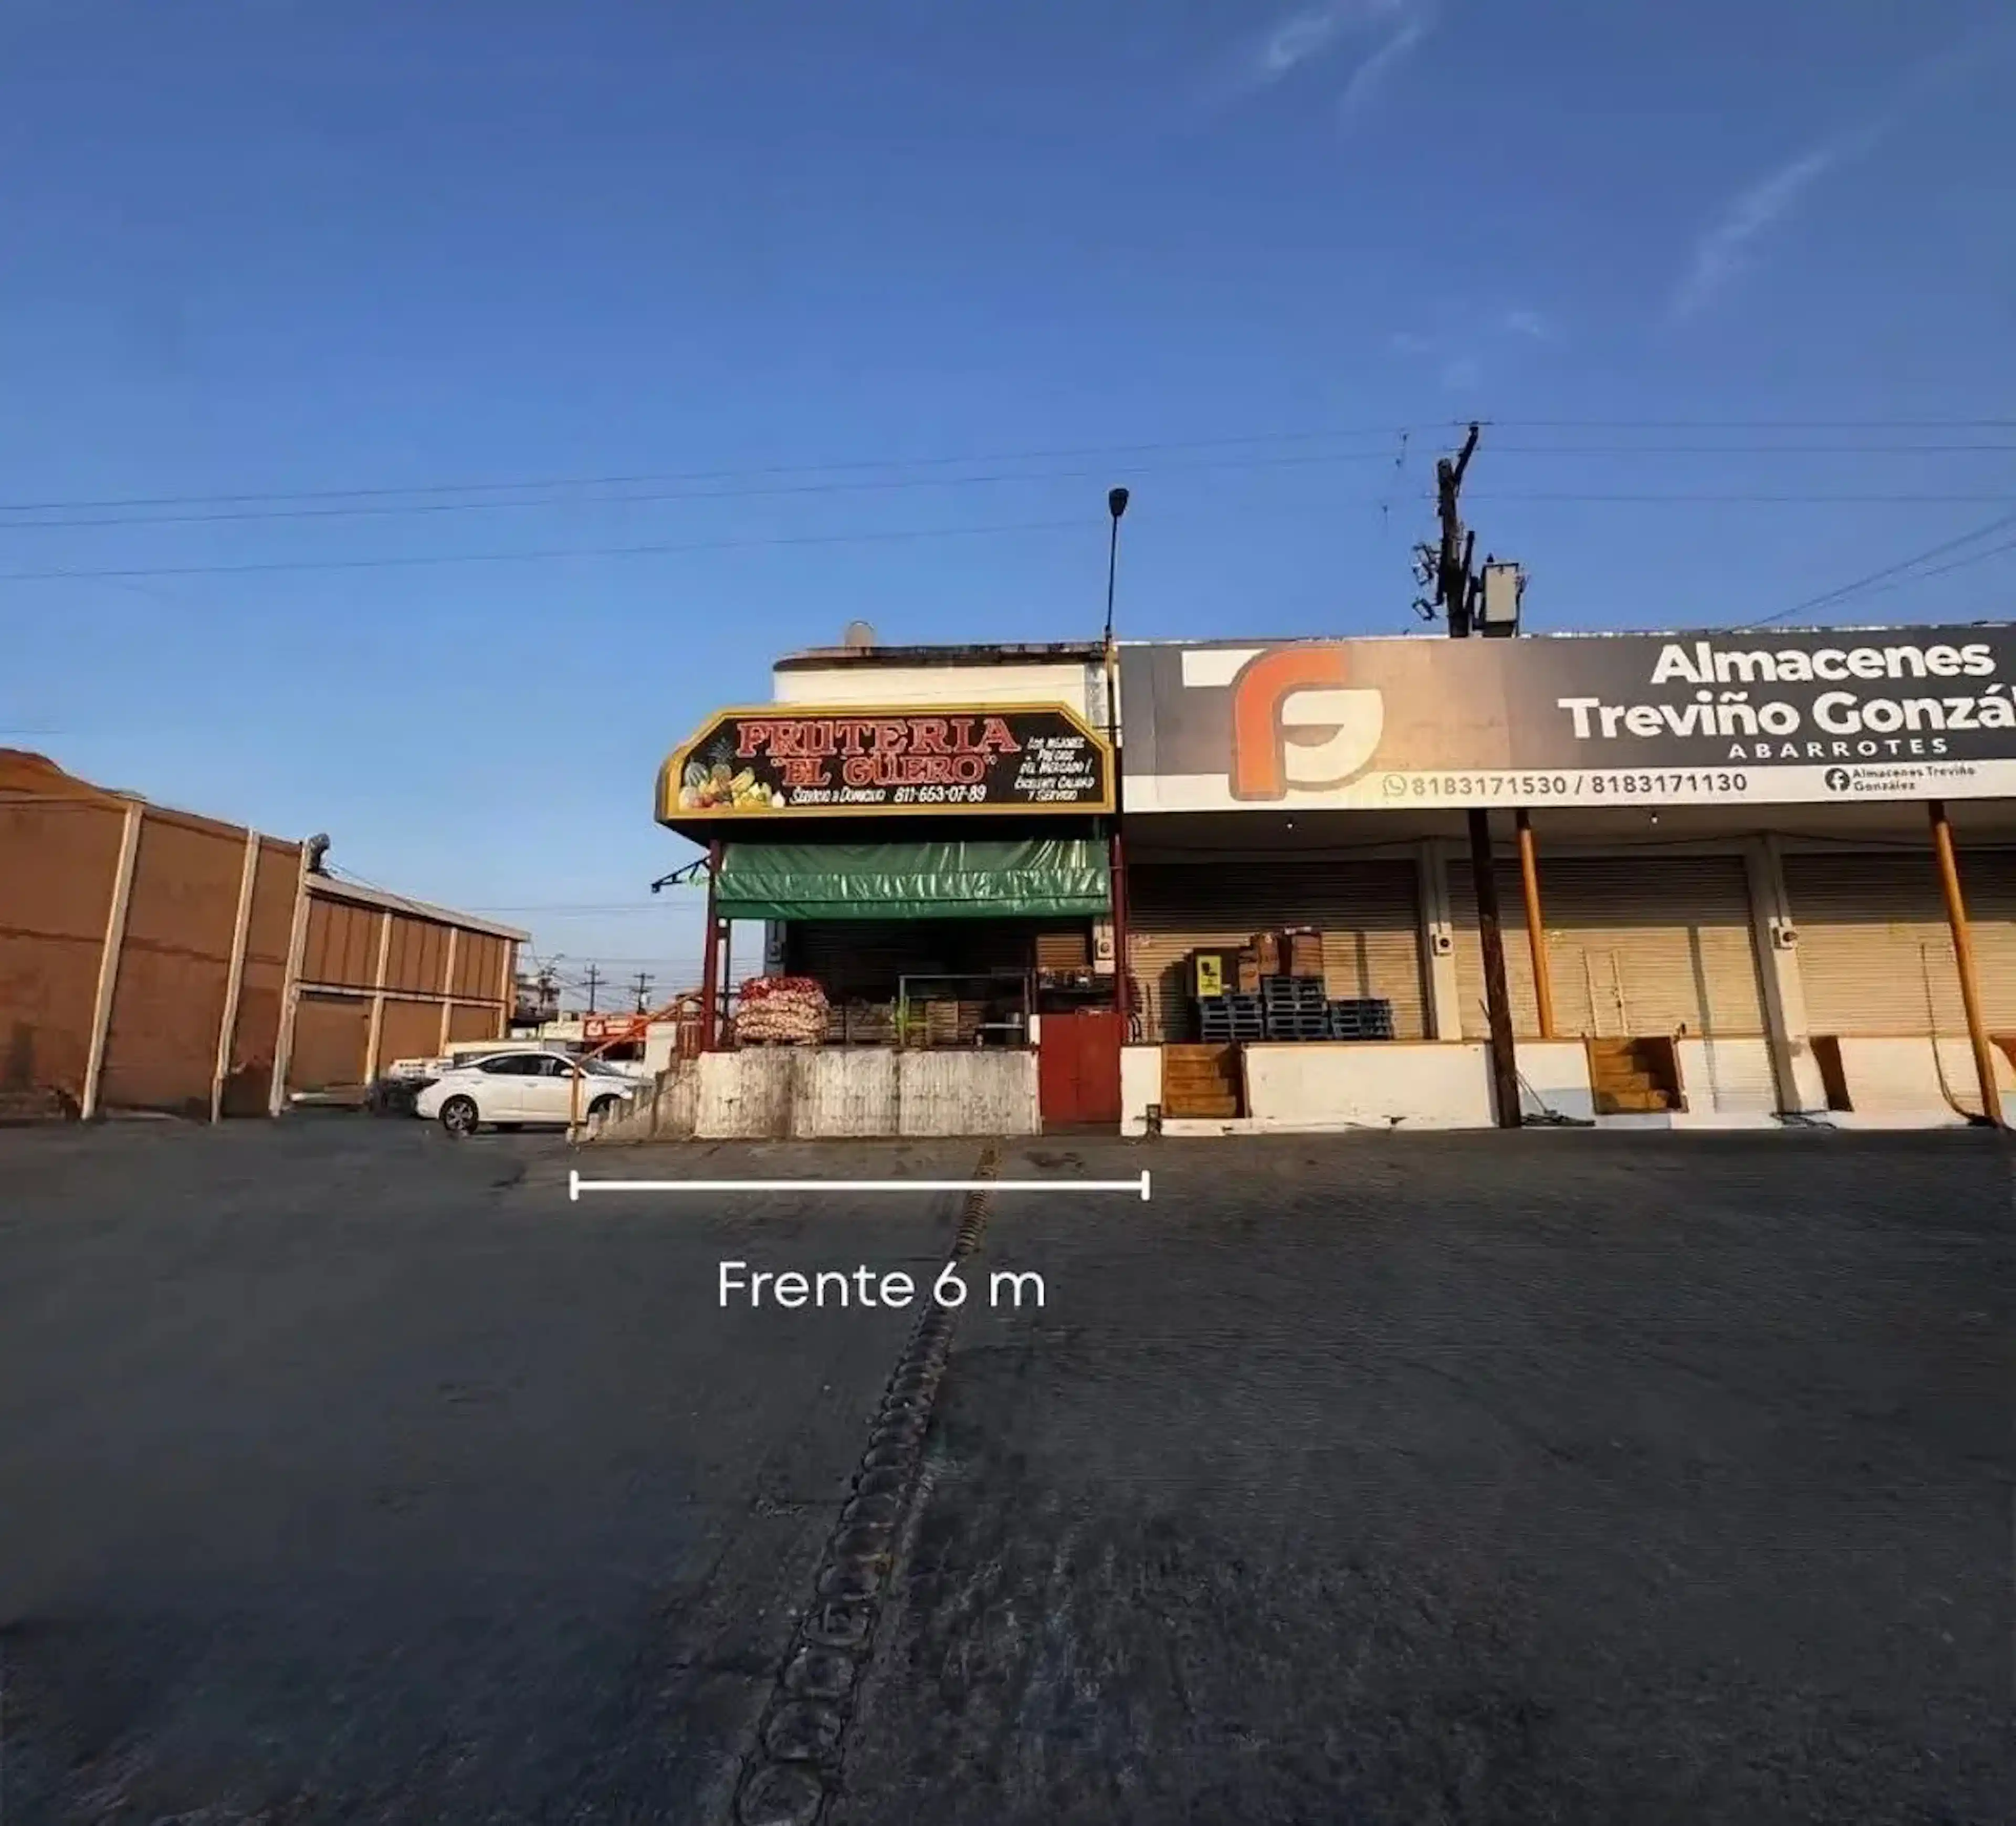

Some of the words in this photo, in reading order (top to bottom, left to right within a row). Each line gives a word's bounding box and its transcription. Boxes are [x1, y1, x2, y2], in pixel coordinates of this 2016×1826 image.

[1651, 642, 1996, 684] Almacenes
[1558, 690, 1801, 738] Treviño
[1812, 683, 2016, 735] Gonzá
[736, 718, 1022, 757] FRUTERIA
[1727, 738, 1949, 760] ABARROTES
[1413, 775, 1565, 796] 8183171530
[1592, 773, 1747, 794] 8183171130
